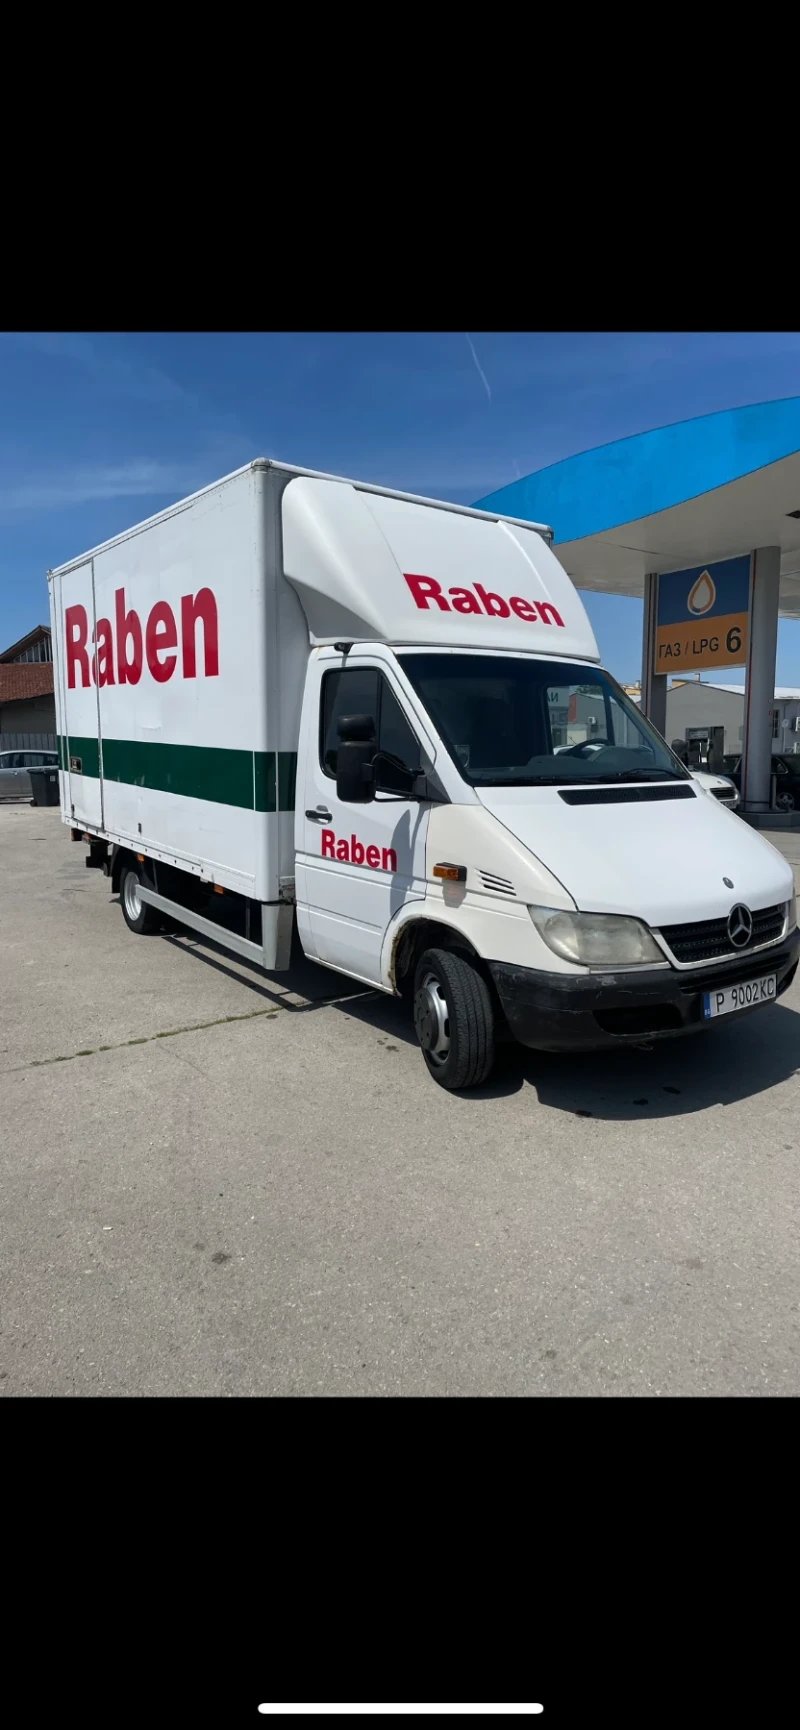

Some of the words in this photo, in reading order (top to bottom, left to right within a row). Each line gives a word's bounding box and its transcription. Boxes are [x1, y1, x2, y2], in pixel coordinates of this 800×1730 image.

[404, 573, 565, 627] Raben
[65, 587, 219, 689] Raben
[659, 643, 681, 659] ГАЗ
[692, 637, 719, 654] LPG
[726, 626, 742, 653] 6
[321, 828, 397, 872] Raben
